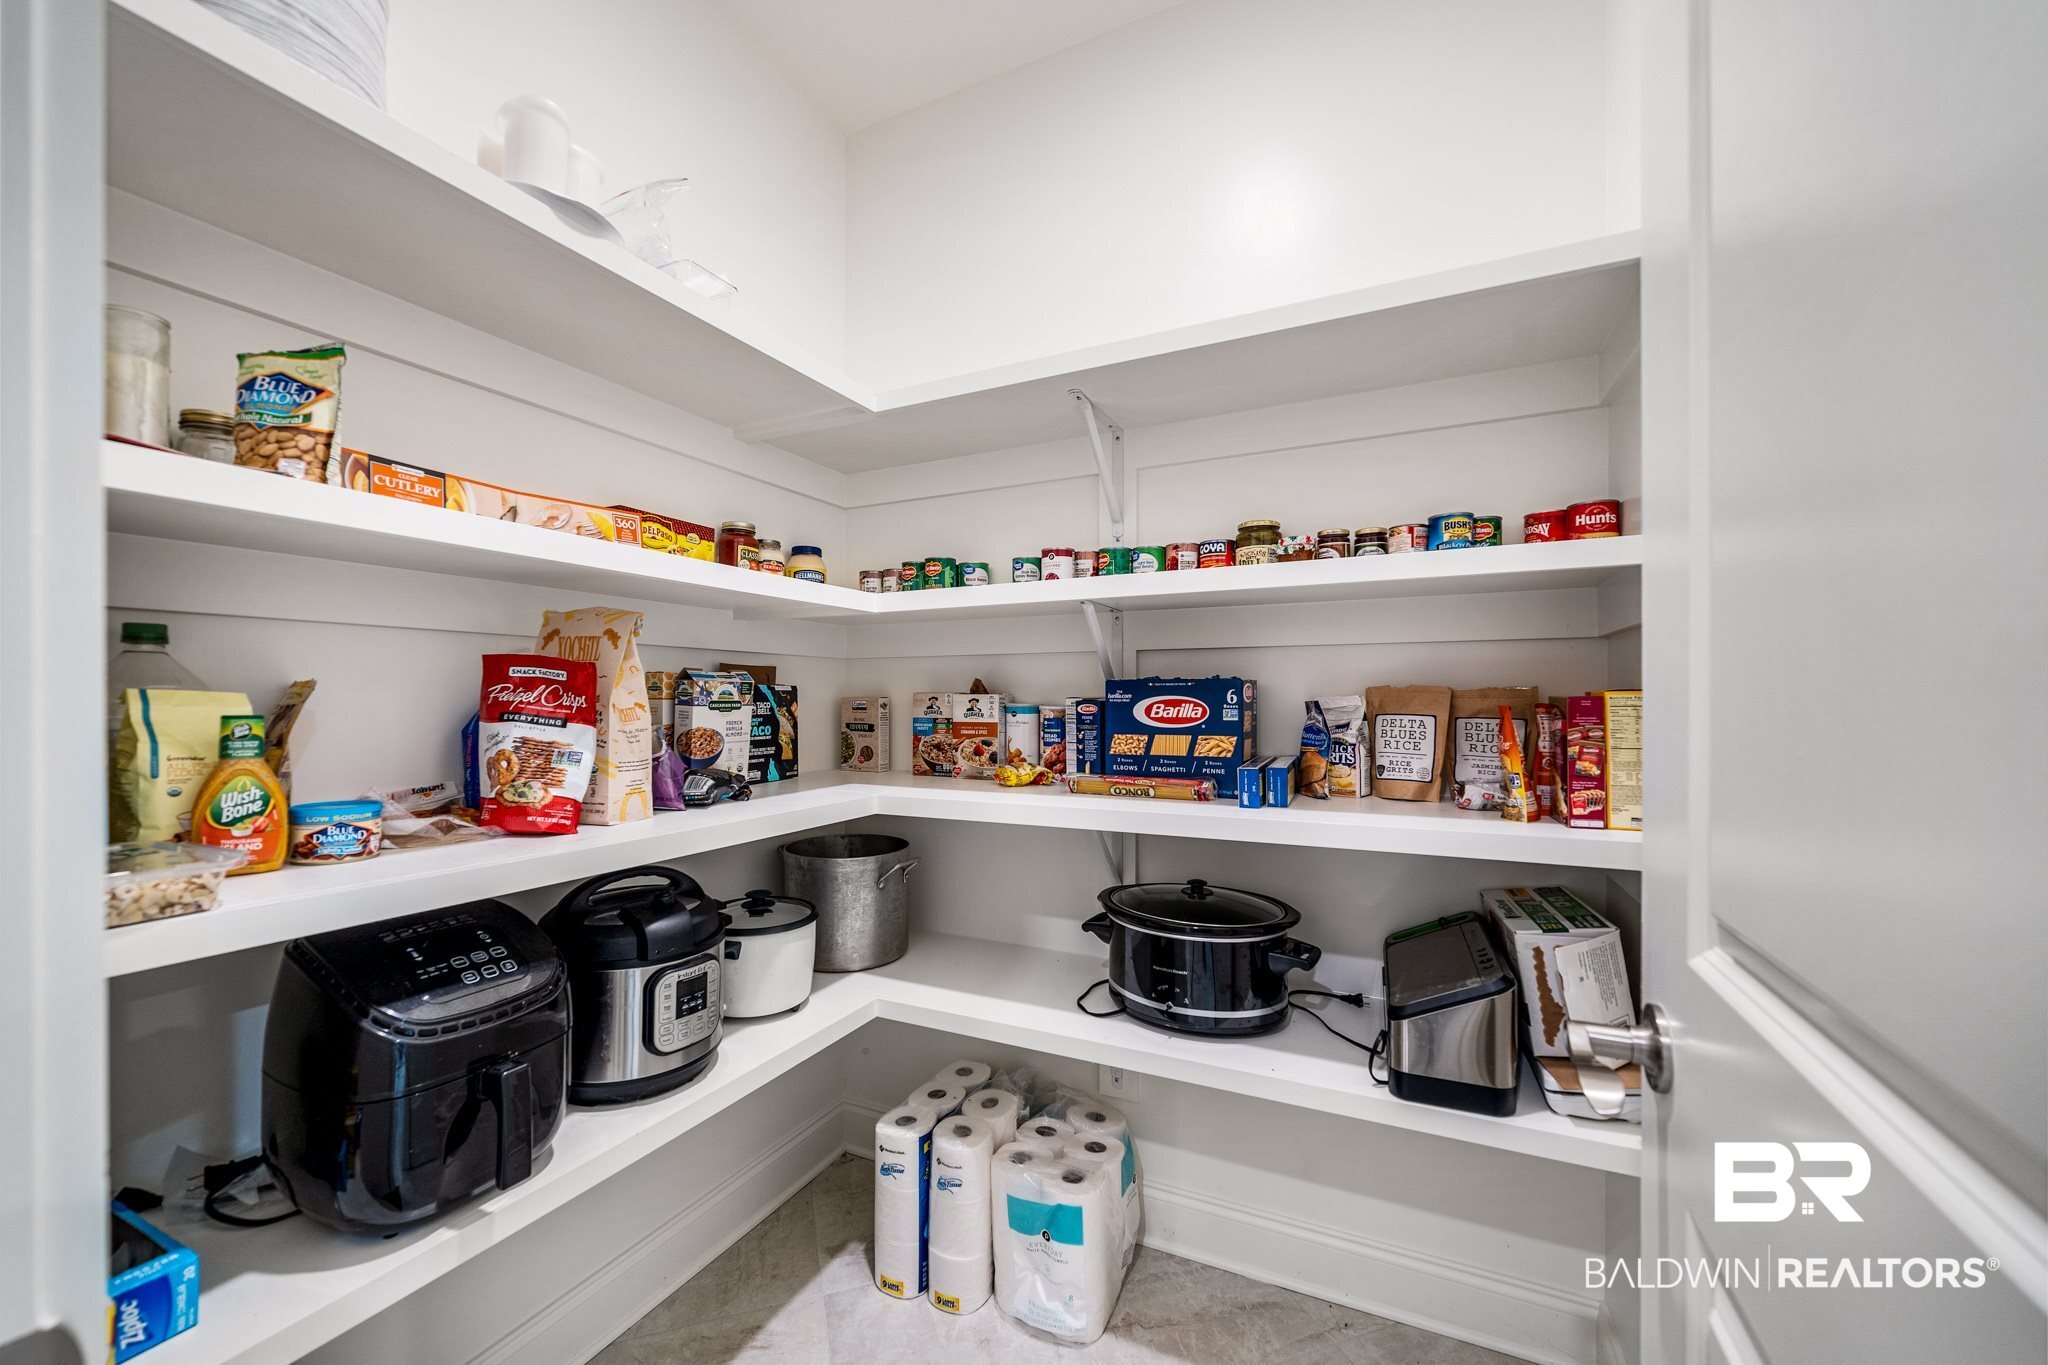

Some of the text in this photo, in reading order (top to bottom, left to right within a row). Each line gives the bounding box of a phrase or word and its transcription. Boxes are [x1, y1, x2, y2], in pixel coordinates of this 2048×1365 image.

[254, 375, 302, 395] BLUE
[236, 388, 317, 405] DIAMOND
[373, 473, 442, 498] CUTLERY
[615, 517, 636, 530] 360
[1200, 542, 1225, 554] GOYA
[487, 683, 546, 711] Pretzel
[541, 685, 589, 714] Crisps
[1226, 688, 1238, 704] 6
[756, 701, 771, 709] TACO
[963, 711, 985, 719] QUAKER
[1149, 703, 1204, 719] Barilla
[503, 713, 562, 727] EVERYTHING
[1381, 718, 1427, 729] DELTA
[1380, 729, 1427, 740] BLUES
[1383, 740, 1422, 751] RICE
[1468, 743, 1500, 754] RIC
[1112, 764, 1138, 772] ELBOWS
[1150, 765, 1186, 773] SPAGHETTI
[1202, 767, 1226, 775] PENNE
[1386, 766, 1414, 774] GRITS
[220, 786, 265, 809] Wish-
[1113, 786, 1151, 798] RONCO
[221, 800, 265, 824] Bone
[306, 811, 373, 823] LOW SODIUM
[326, 826, 355, 836] BLUE
[220, 837, 264, 845] THOUSAND
[312, 831, 368, 844] DIAMOND
[677, 969, 697, 980] Instant
[890, 1165, 905, 1174] Tissue
[1029, 1241, 1063, 1259] EVERYDAY
[882, 1279, 888, 1288] 9
[936, 1295, 942, 1304] 9
[117, 1299, 148, 1350] Ziploc
